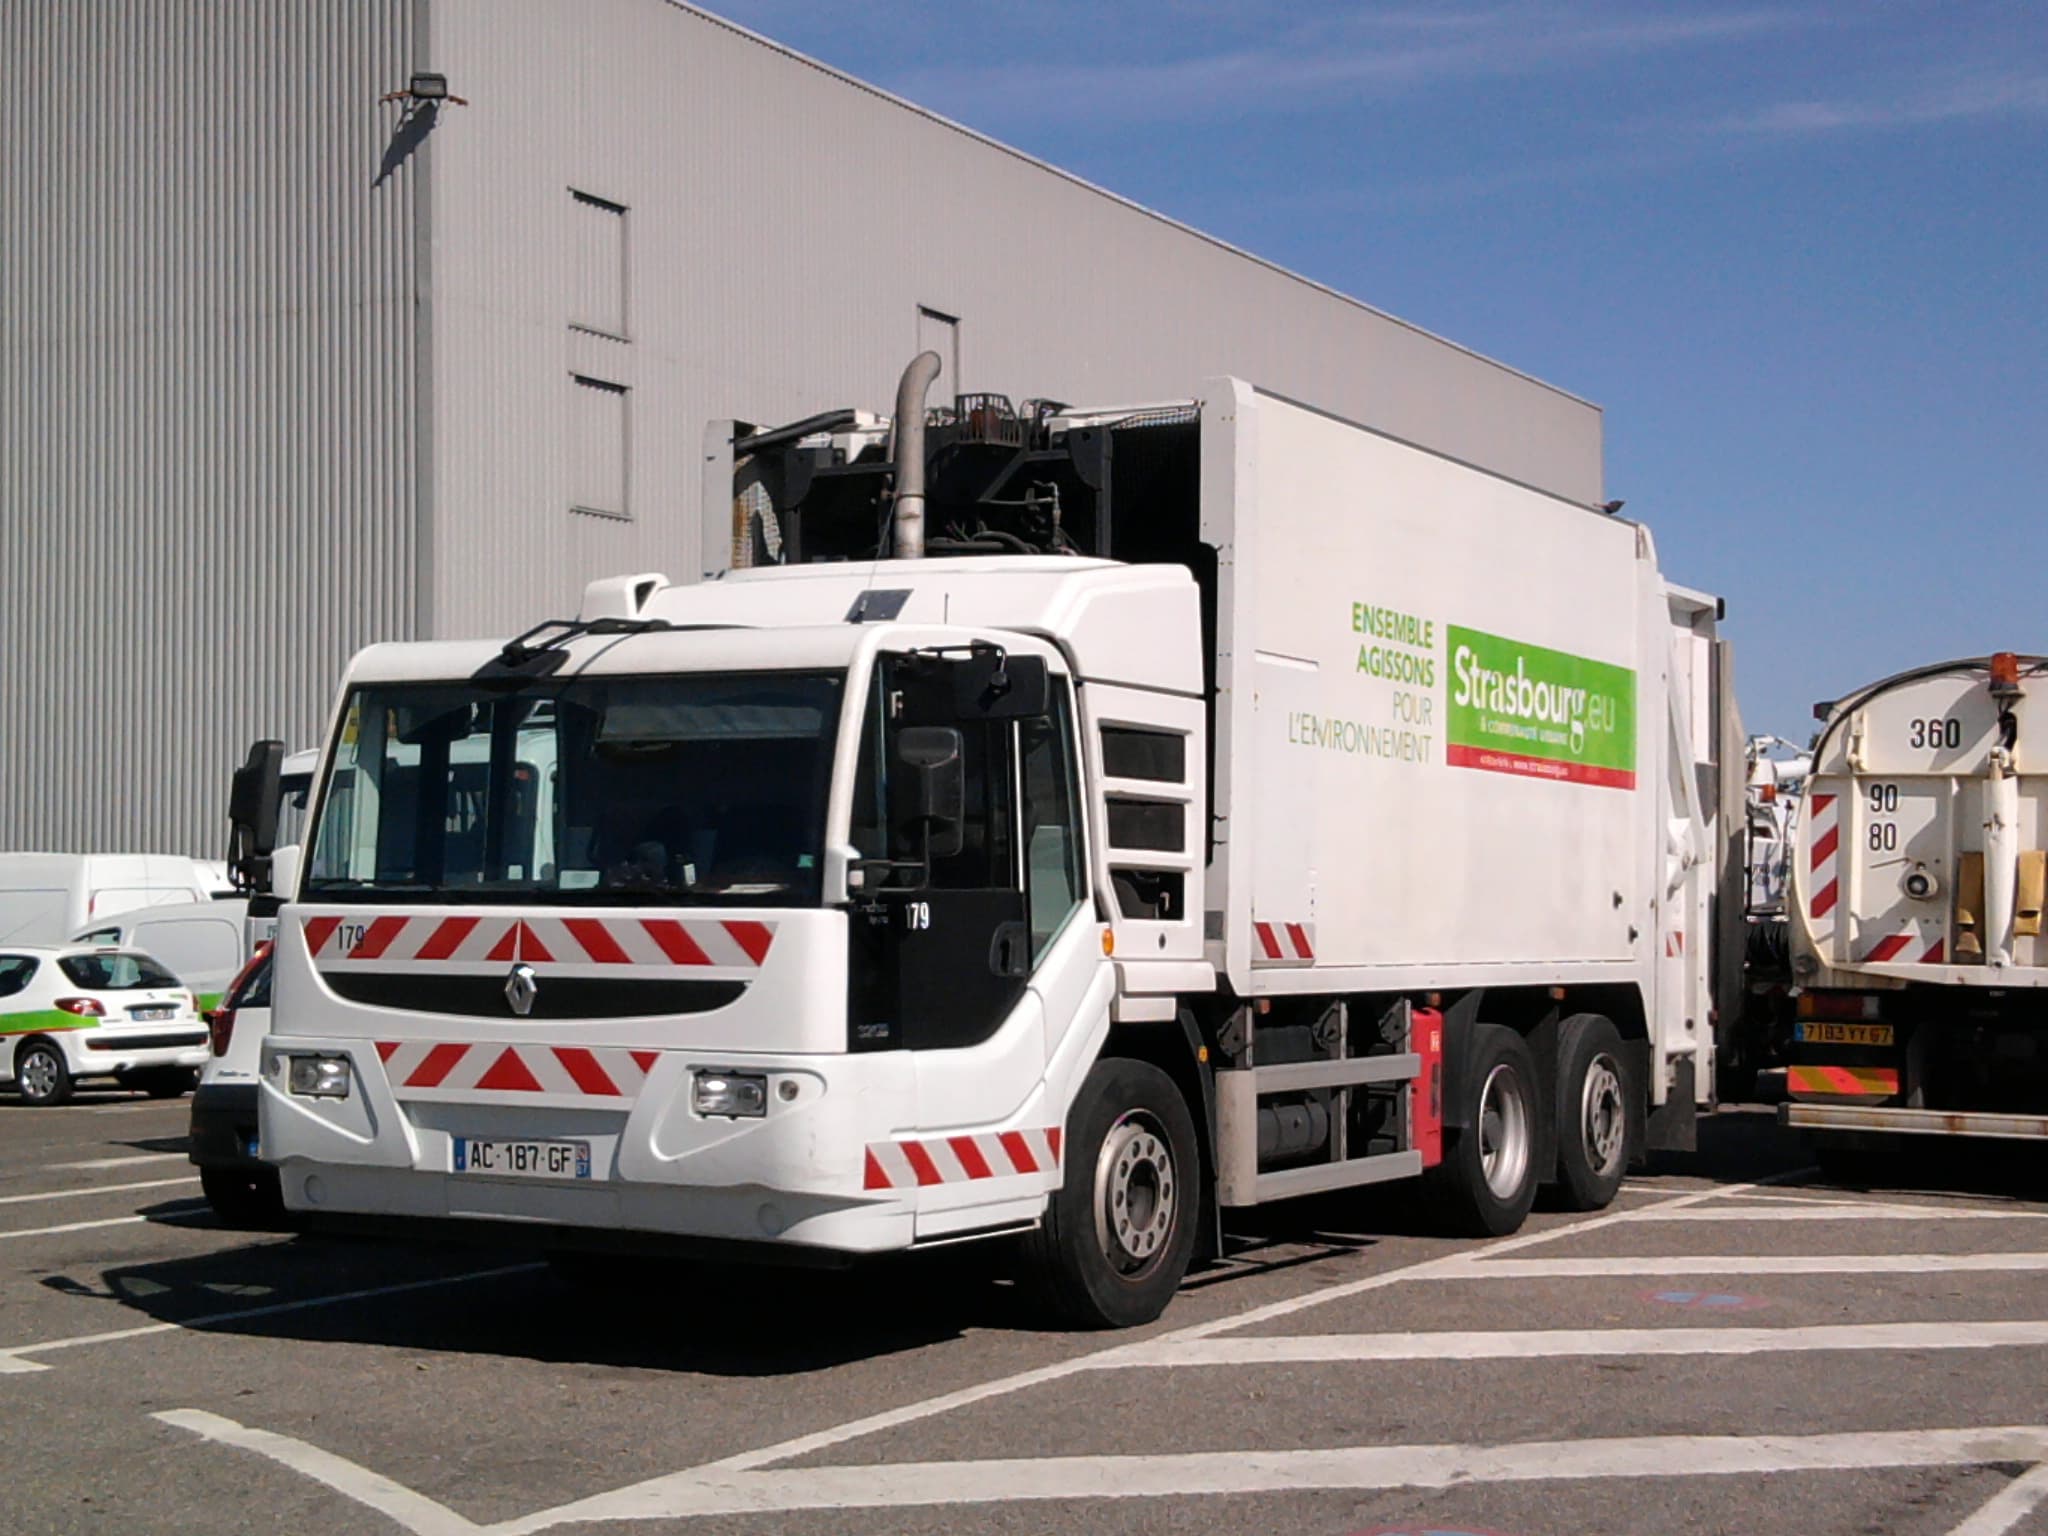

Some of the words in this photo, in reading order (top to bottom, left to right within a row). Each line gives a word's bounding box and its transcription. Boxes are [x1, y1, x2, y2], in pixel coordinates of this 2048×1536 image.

[1351, 601, 1434, 650] ENSEMBLE
[1355, 643, 1435, 688] AGISSONS
[1392, 690, 1433, 727] POUR
[1288, 711, 1432, 765] L'ENVIRONNEMENT
[1910, 718, 1961, 749] 360
[1869, 783, 1898, 813] 90
[1868, 822, 1897, 851] 80
[338, 924, 366, 951] 179
